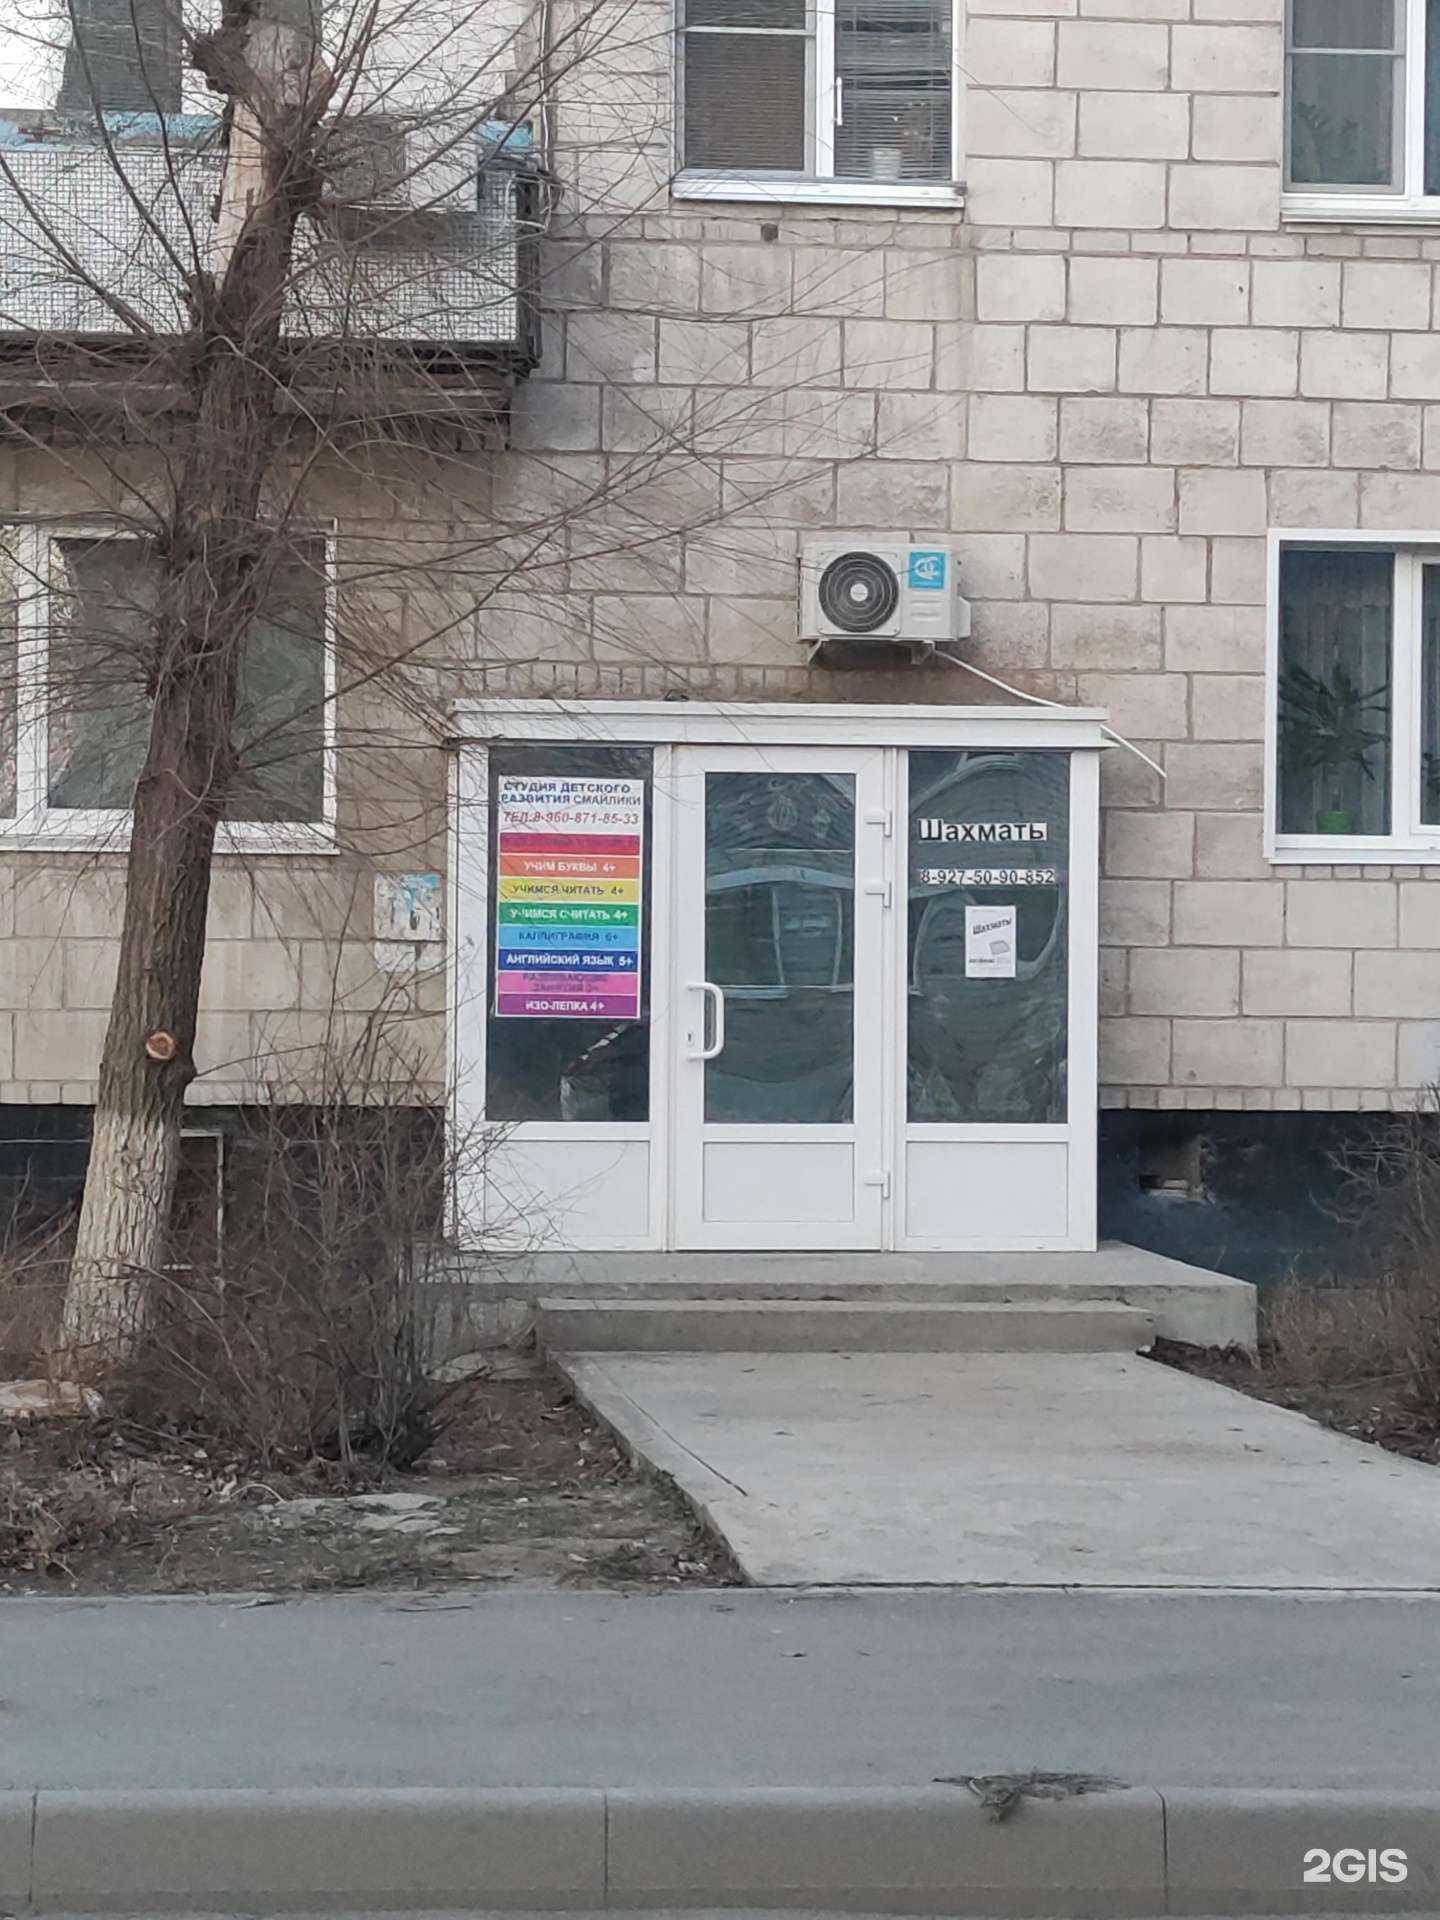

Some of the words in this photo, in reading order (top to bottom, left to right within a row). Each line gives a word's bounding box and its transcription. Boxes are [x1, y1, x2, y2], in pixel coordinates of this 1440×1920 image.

[503, 781, 557, 793] СТУДИЯ
[561, 782, 631, 794] ДЕТСКОГО
[573, 794, 641, 806] СМАЙЛИКИ
[525, 862, 555, 872] УЧИМ
[558, 862, 597, 872] БУКВЫ
[602, 864, 617, 872] 4+
[920, 869, 1054, 885] 8-927-50-90-852
[512, 884, 558, 893] УЧИМСЯ
[561, 885, 605, 895] ЧИТАТЬ
[610, 886, 624, 895] 4+
[510, 908, 557, 918] УЧИМСЯ
[558, 908, 610, 919] СЧИТАТЬ
[613, 910, 629, 919] 4+
[506, 953, 580, 965] АНГЛИЙСКИЙ
[582, 956, 614, 967] ЯЗЫК
[618, 956, 634, 966] 5+
[525, 1000, 588, 1011] ИЗО-ЛЕПКА
